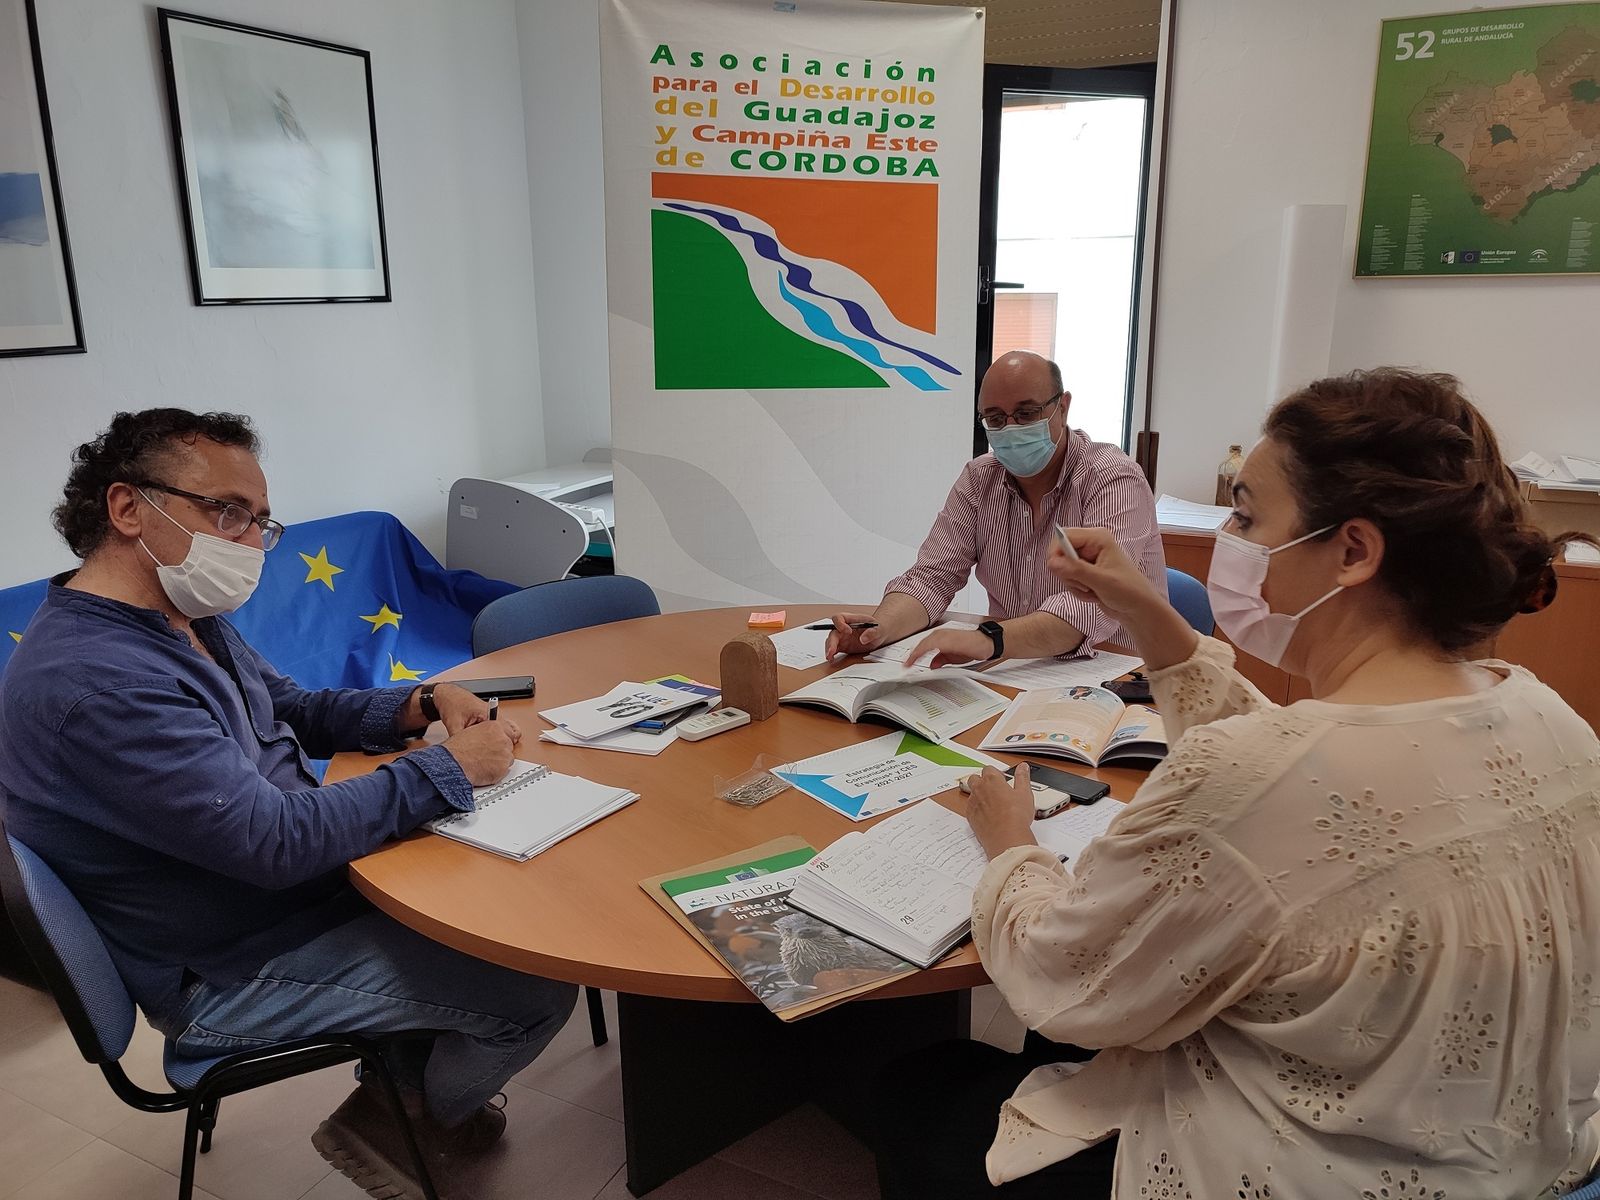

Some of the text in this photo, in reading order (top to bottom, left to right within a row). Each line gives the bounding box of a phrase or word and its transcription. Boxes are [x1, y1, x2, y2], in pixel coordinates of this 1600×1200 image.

[1442, 26, 1469, 35] GRUPOS
[1481, 22, 1524, 32] DESARROLLO
[1474, 32, 1514, 41] ANDALUCÍA
[1395, 31, 1435, 60] 52
[649, 44, 935, 82] Asociación
[652, 76, 936, 105] para el Desarrollo
[655, 96, 936, 133] del Guadajoz
[655, 124, 938, 152] y Campiña Este
[655, 146, 940, 177] de CORDOBA
[845, 762, 885, 778] Estrategia
[845, 764, 900, 784] Comunicación
[900, 764, 918, 772] CES
[816, 861, 829, 872] 28
[715, 881, 789, 903] NATURA
[728, 903, 762, 914] State
[764, 897, 777, 908] of
[749, 907, 771, 918] the
[771, 904, 789, 913] EU
[900, 915, 914, 925] 29
